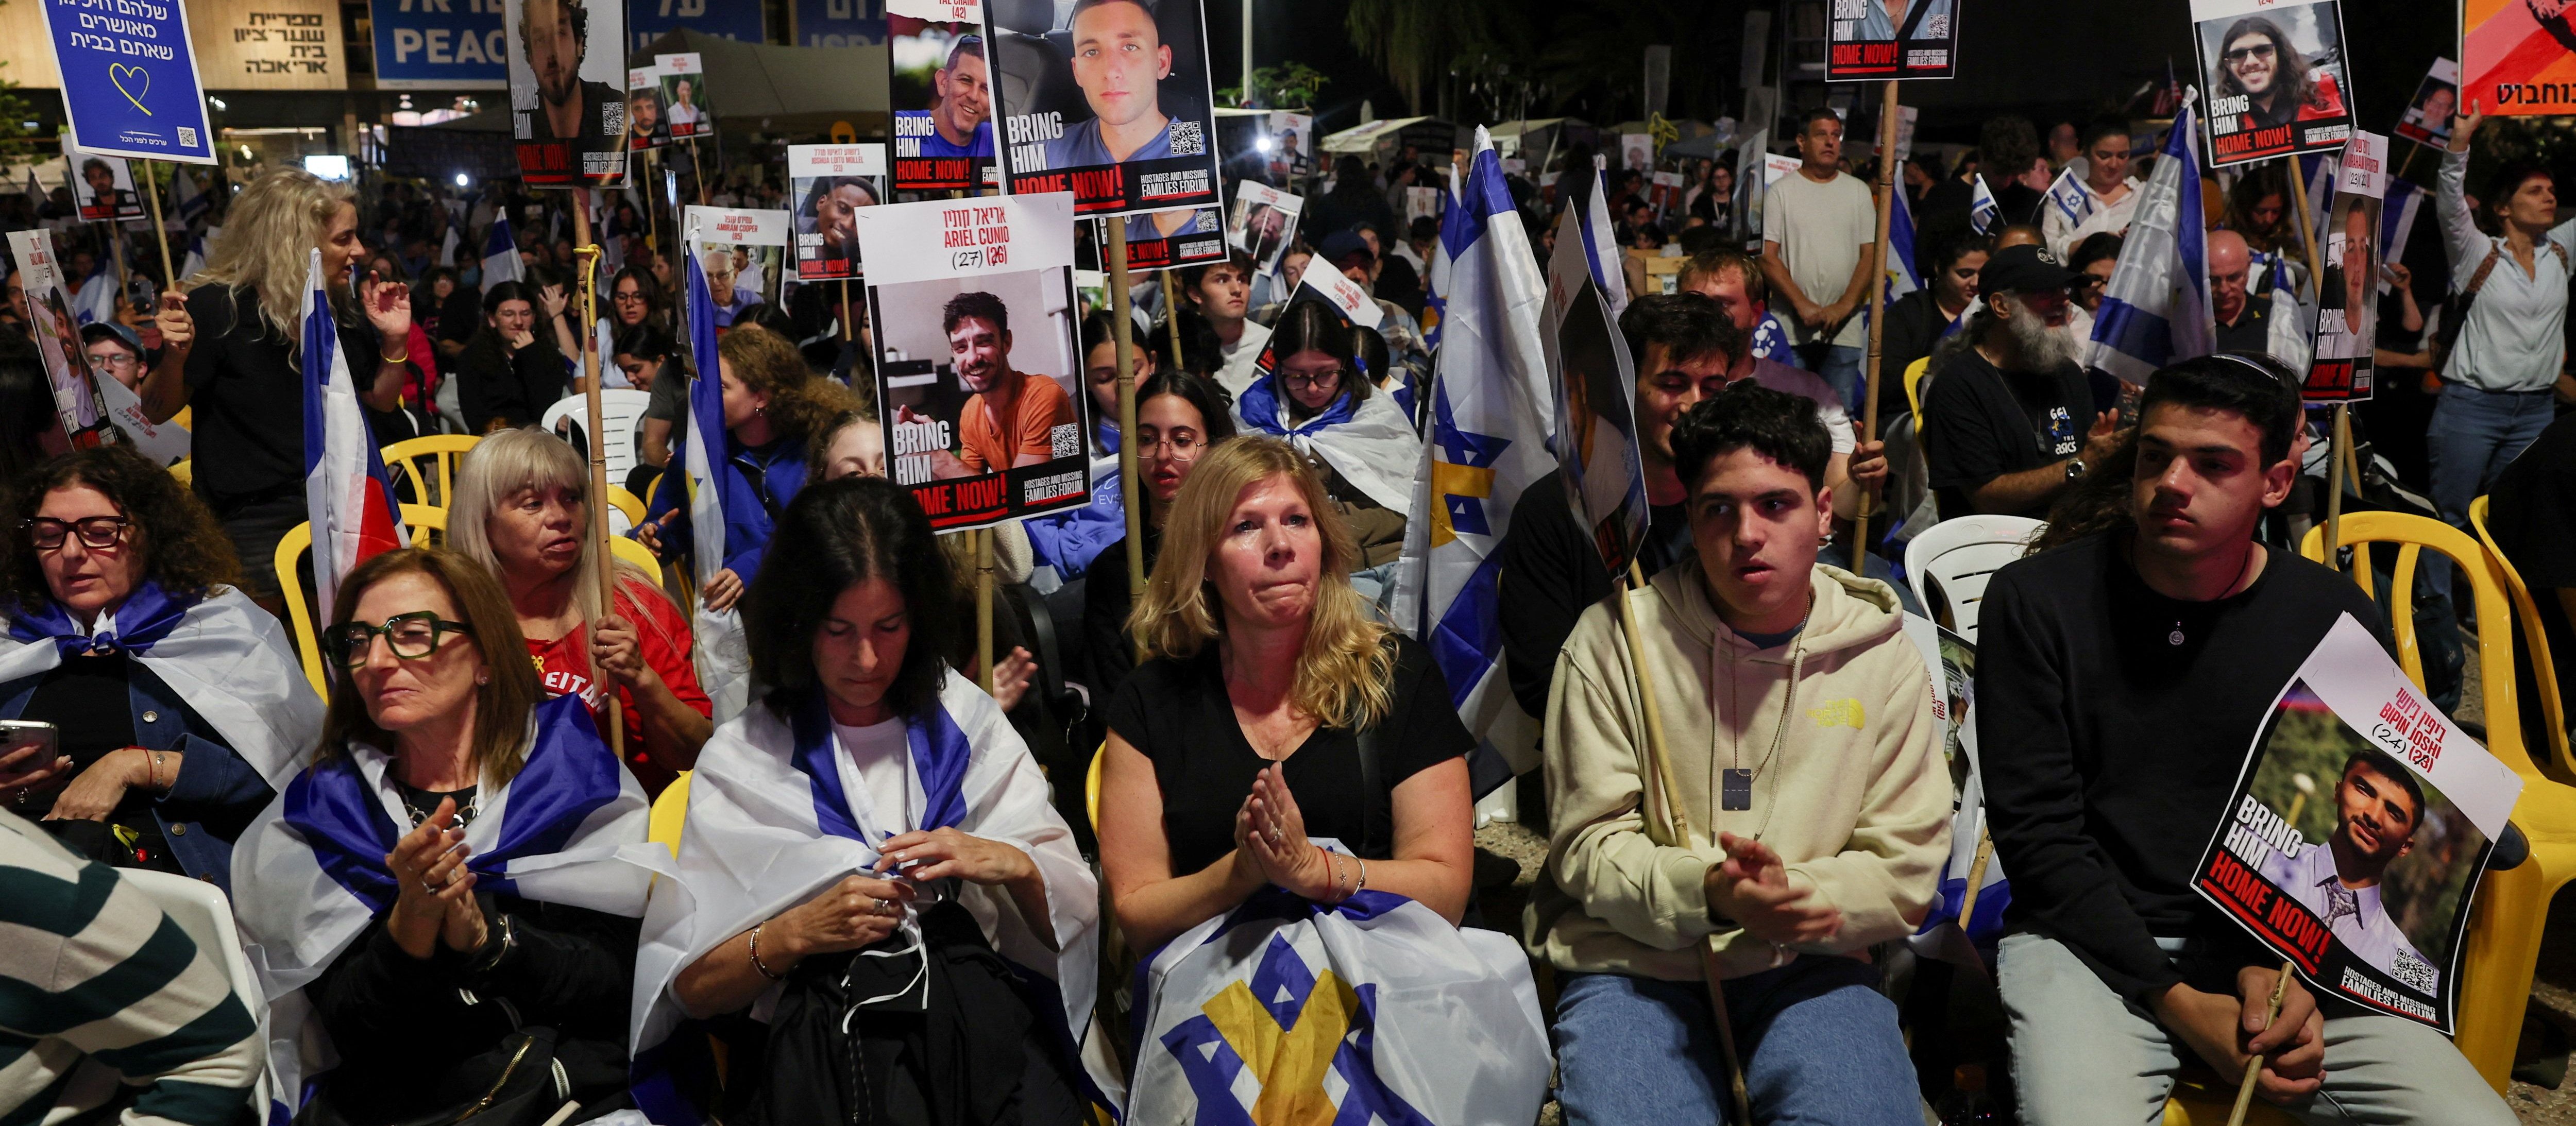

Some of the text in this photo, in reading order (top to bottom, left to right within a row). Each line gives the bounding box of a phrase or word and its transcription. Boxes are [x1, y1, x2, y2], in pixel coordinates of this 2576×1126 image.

[117, 0, 167, 21] שלהם
[249, 12, 323, 26] ספריית
[953, 6, 966, 19] (42)
[1834, 0, 1868, 19] BRING
[79, 12, 157, 39] מאושרים
[234, 29, 325, 42] שער ציון
[1833, 21, 1854, 41] HIM
[71, 31, 174, 61] שאתם בבית
[291, 46, 327, 58] בית
[394, 28, 505, 64] PEAC
[1833, 41, 1898, 64] HOME NOW!
[245, 60, 328, 73] אריאלה
[1907, 56, 1947, 65] FAMILIES FORUM
[511, 85, 539, 110] BRING
[2211, 95, 2249, 117] BRING
[513, 111, 532, 139] HIM
[895, 116, 934, 136] BRING
[1006, 111, 1064, 144] BRING
[2213, 114, 2238, 135] HIM
[119, 134, 133, 143] הכל
[2216, 124, 2293, 155] HOME NOW!
[2306, 130, 2350, 143] FAMILIES FORUM
[896, 138, 920, 157] HIM
[896, 158, 970, 180] HOME NOW!
[1010, 144, 1047, 174] HIM
[982, 173, 998, 182] FAMIL
[1072, 165, 1124, 199] NOW!
[1141, 169, 1208, 184] HOSTAGES AND MISSING
[1141, 178, 1209, 197] FAMILIES FORUM
[717, 224, 738, 232] AMIRAM
[943, 207, 1006, 228] אריאל קוניו
[799, 233, 824, 246] BRING
[944, 226, 1010, 248] ARIEL CUNIO
[799, 246, 816, 260] HIM
[987, 245, 1007, 266] (26)
[1137, 238, 1168, 259] NOW!
[1180, 245, 1221, 258] FAMILIES FORUM
[800, 260, 824, 272] HOME
[825, 258, 849, 272] NOW!
[953, 250, 983, 270] (27)
[2319, 309, 2344, 333] BRING
[2316, 335, 2334, 359] HIM
[892, 420, 951, 456] BRING
[895, 454, 932, 486] HIM
[1024, 470, 1083, 490] HOSTAGES AND MISSING
[912, 473, 1007, 515] OME NOW!
[1025, 480, 1084, 503] FAMILIES FORUM
[1937, 700, 1945, 720] (85)
[2379, 702, 2442, 759] BIPIN JOSHI
[2417, 711, 2446, 743] ביפין
[2372, 723, 2406, 754] (24)
[2236, 793, 2303, 858] BRING
[2223, 820, 2269, 872] HIM
[2209, 850, 2332, 963] HOME NOW!
[2341, 974, 2437, 1022] FAMILIES FORUM
[2344, 965, 2436, 1014] HOSTAGES AND MISSING
